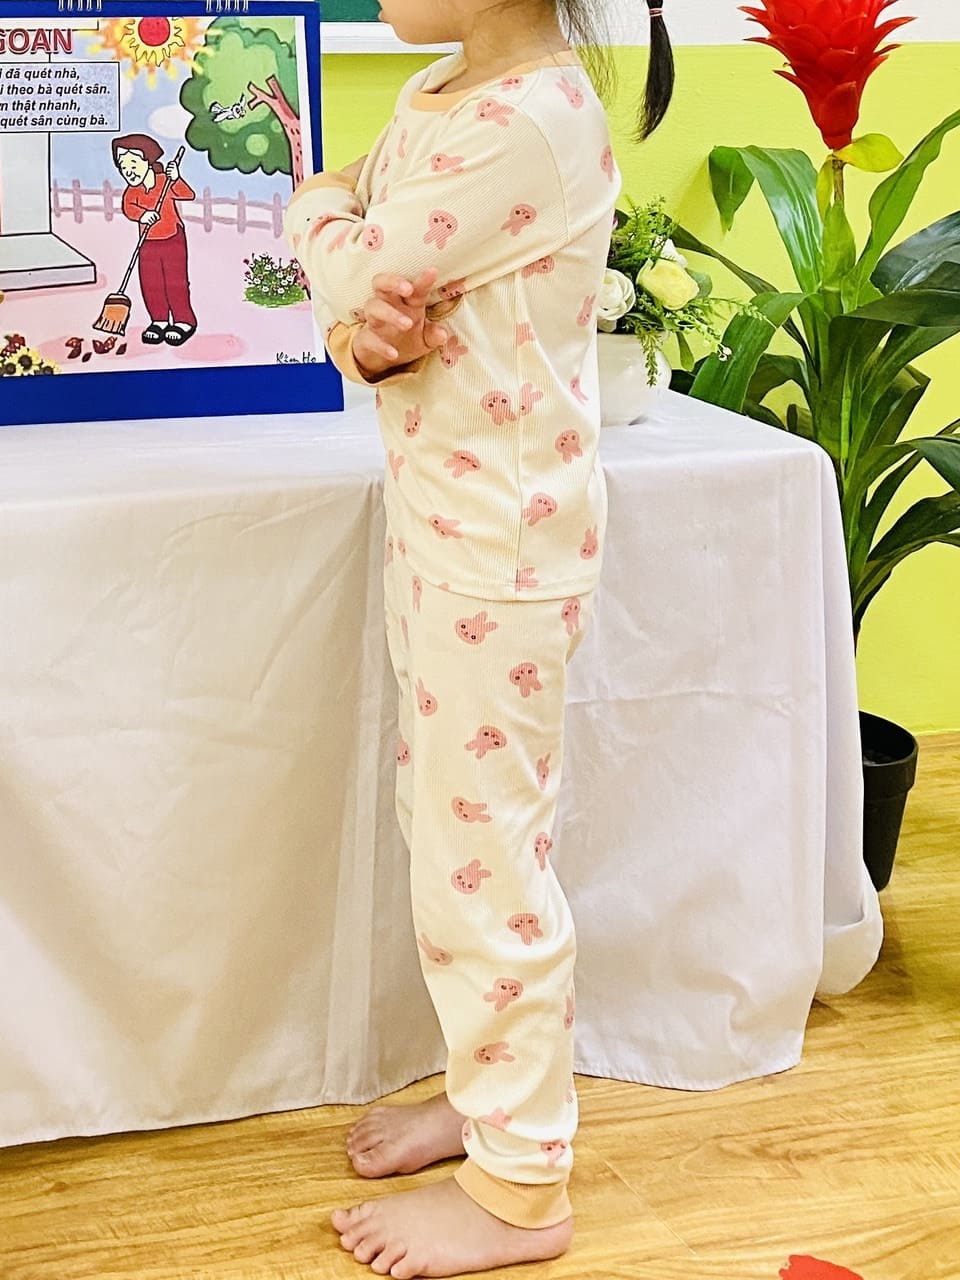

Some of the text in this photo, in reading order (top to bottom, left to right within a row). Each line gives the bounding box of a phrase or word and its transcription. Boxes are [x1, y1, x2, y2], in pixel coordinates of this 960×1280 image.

[5, 68, 20, 78] đã
[24, 68, 52, 81] quét
[54, 67, 80, 80] nhà,
[7, 84, 34, 95] theo
[37, 84, 52, 94] bà
[56, 84, 83, 96] quét
[85, 83, 111, 94] sân.
[12, 100, 36, 113] thật
[39, 99, 80, 112] nhanh,
[0, 115, 28, 128] quét
[31, 115, 52, 126] sân
[56, 114, 87, 127] cùng
[90, 113, 108, 125] bà.
